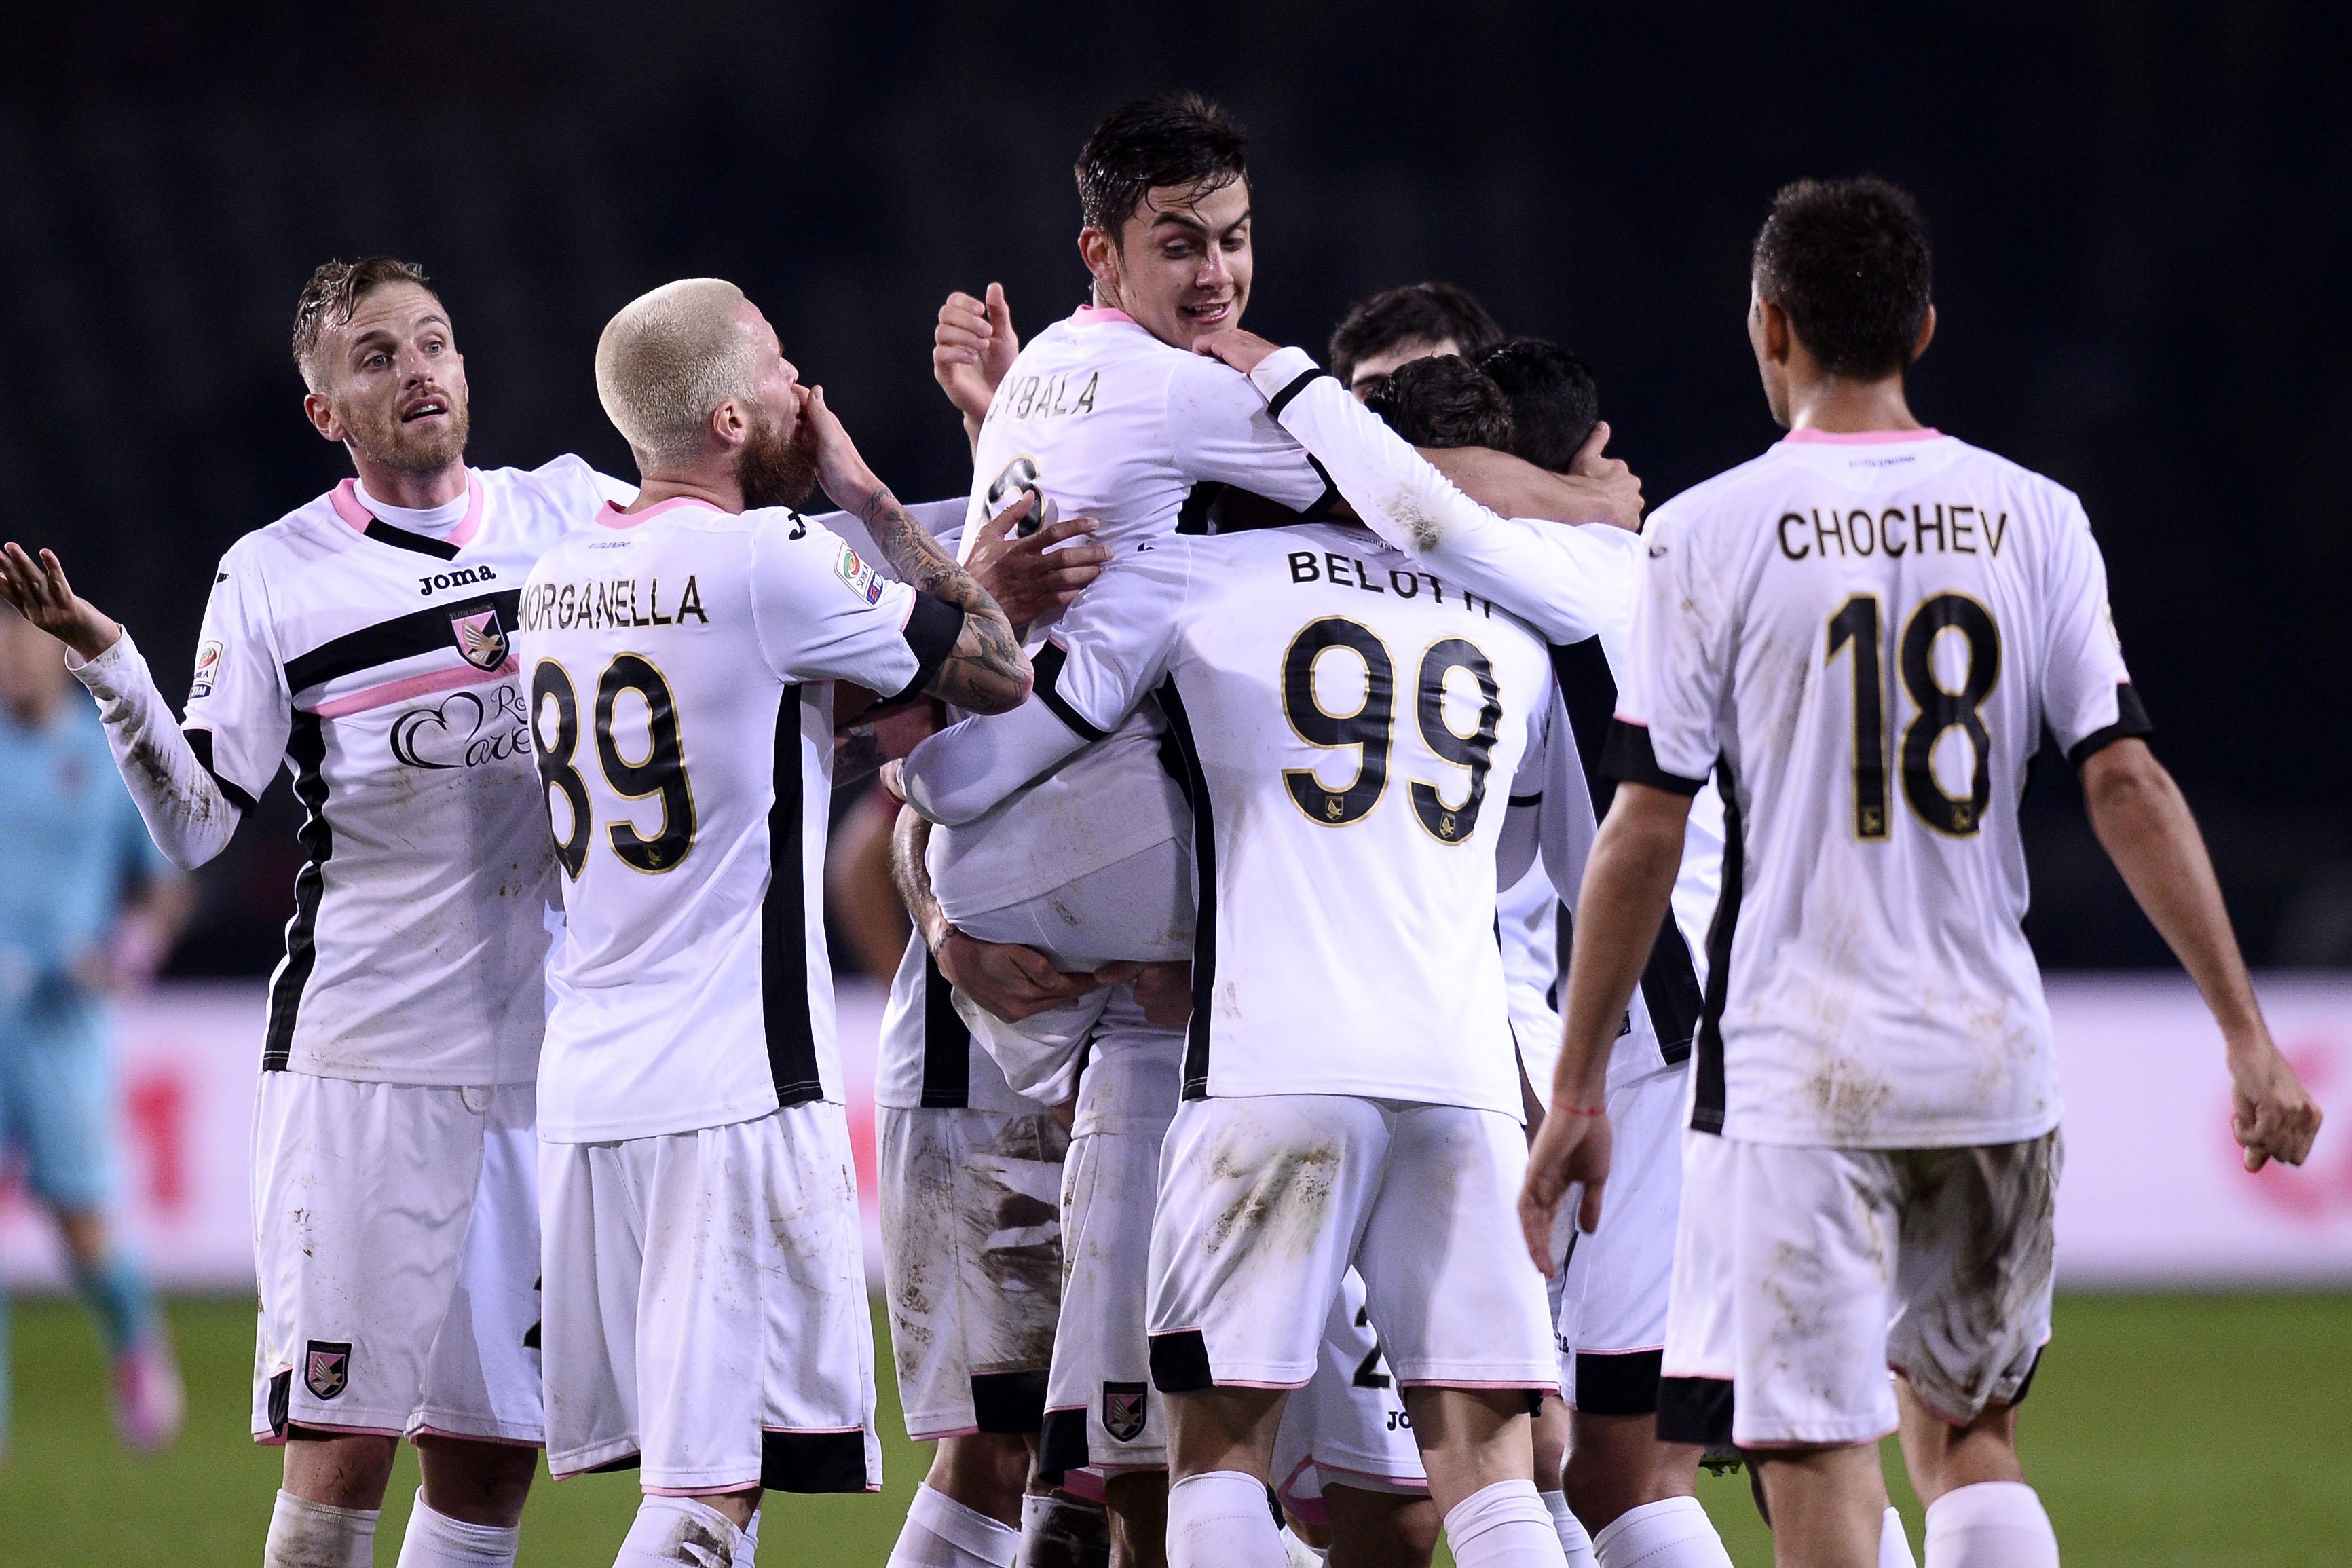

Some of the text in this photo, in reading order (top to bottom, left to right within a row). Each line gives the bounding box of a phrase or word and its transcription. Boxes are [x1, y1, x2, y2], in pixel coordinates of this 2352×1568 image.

[1776, 504, 2008, 561] CHOCHEV
[531, 650, 698, 884] 89
[1280, 614, 1504, 847] 99
[1824, 589, 2003, 842] 18
